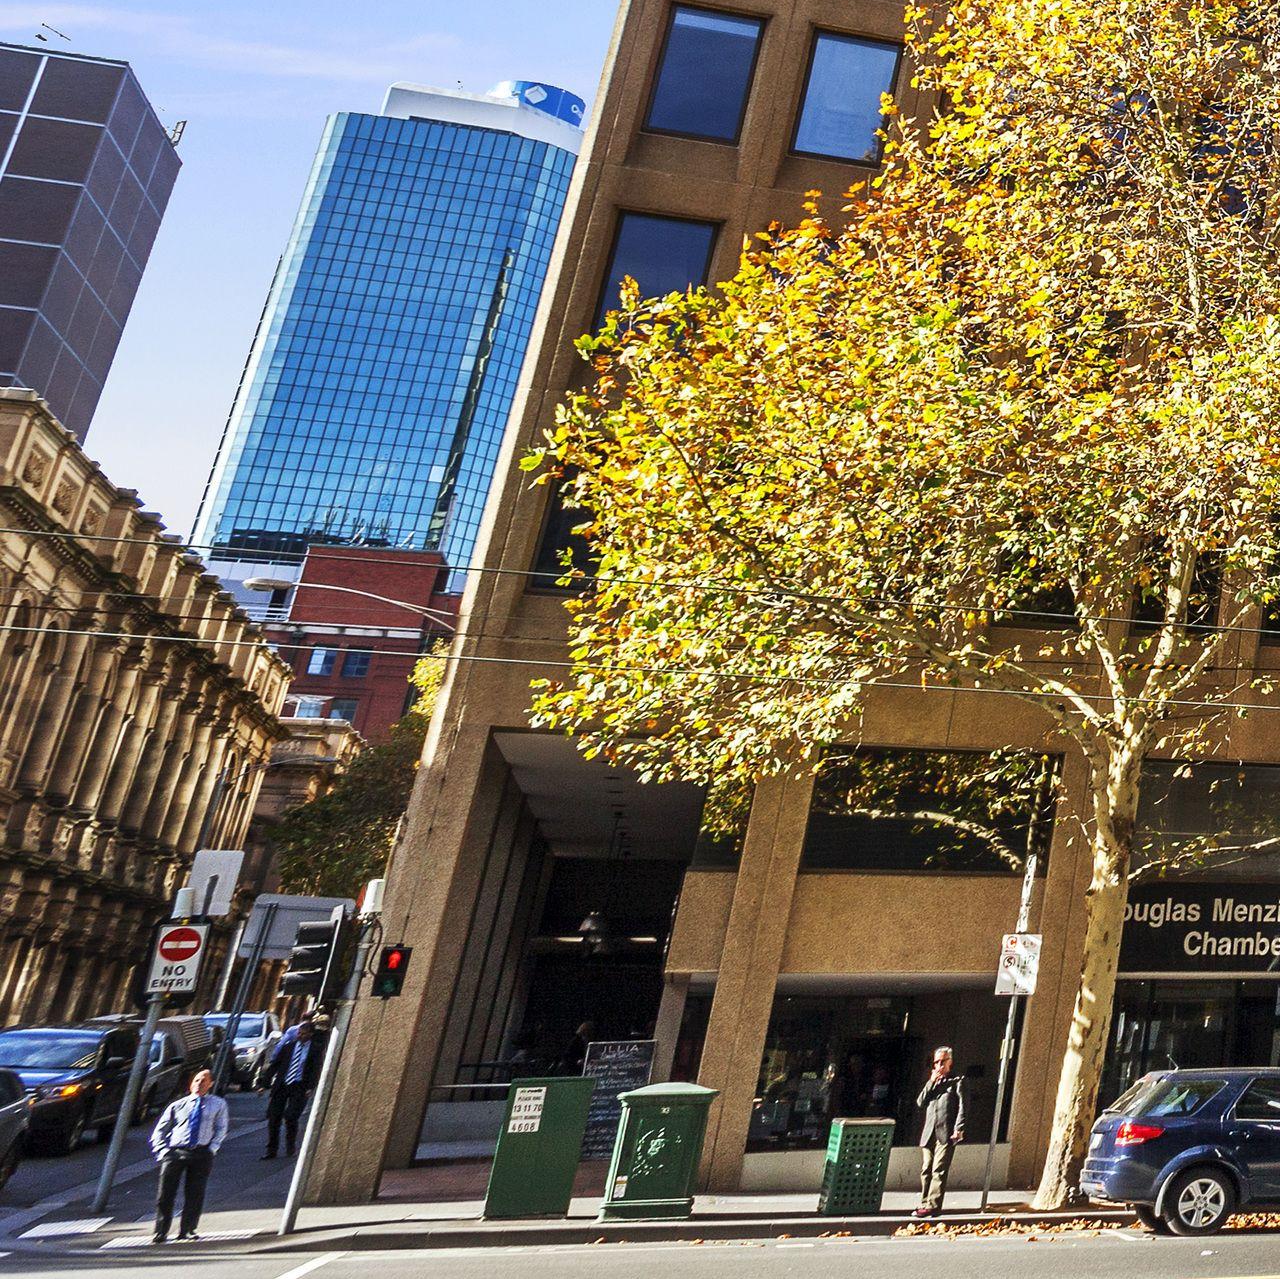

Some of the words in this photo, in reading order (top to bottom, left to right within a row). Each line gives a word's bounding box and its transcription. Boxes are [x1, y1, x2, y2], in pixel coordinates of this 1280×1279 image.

[1124, 897, 1201, 928] ouglas
[162, 965, 187, 976] NO
[151, 978, 193, 988] ENTRY
[513, 1104, 522, 1112] 13
[524, 1104, 531, 1112] 11
[533, 1103, 543, 1112] 70
[511, 1121, 536, 1132] 4608
